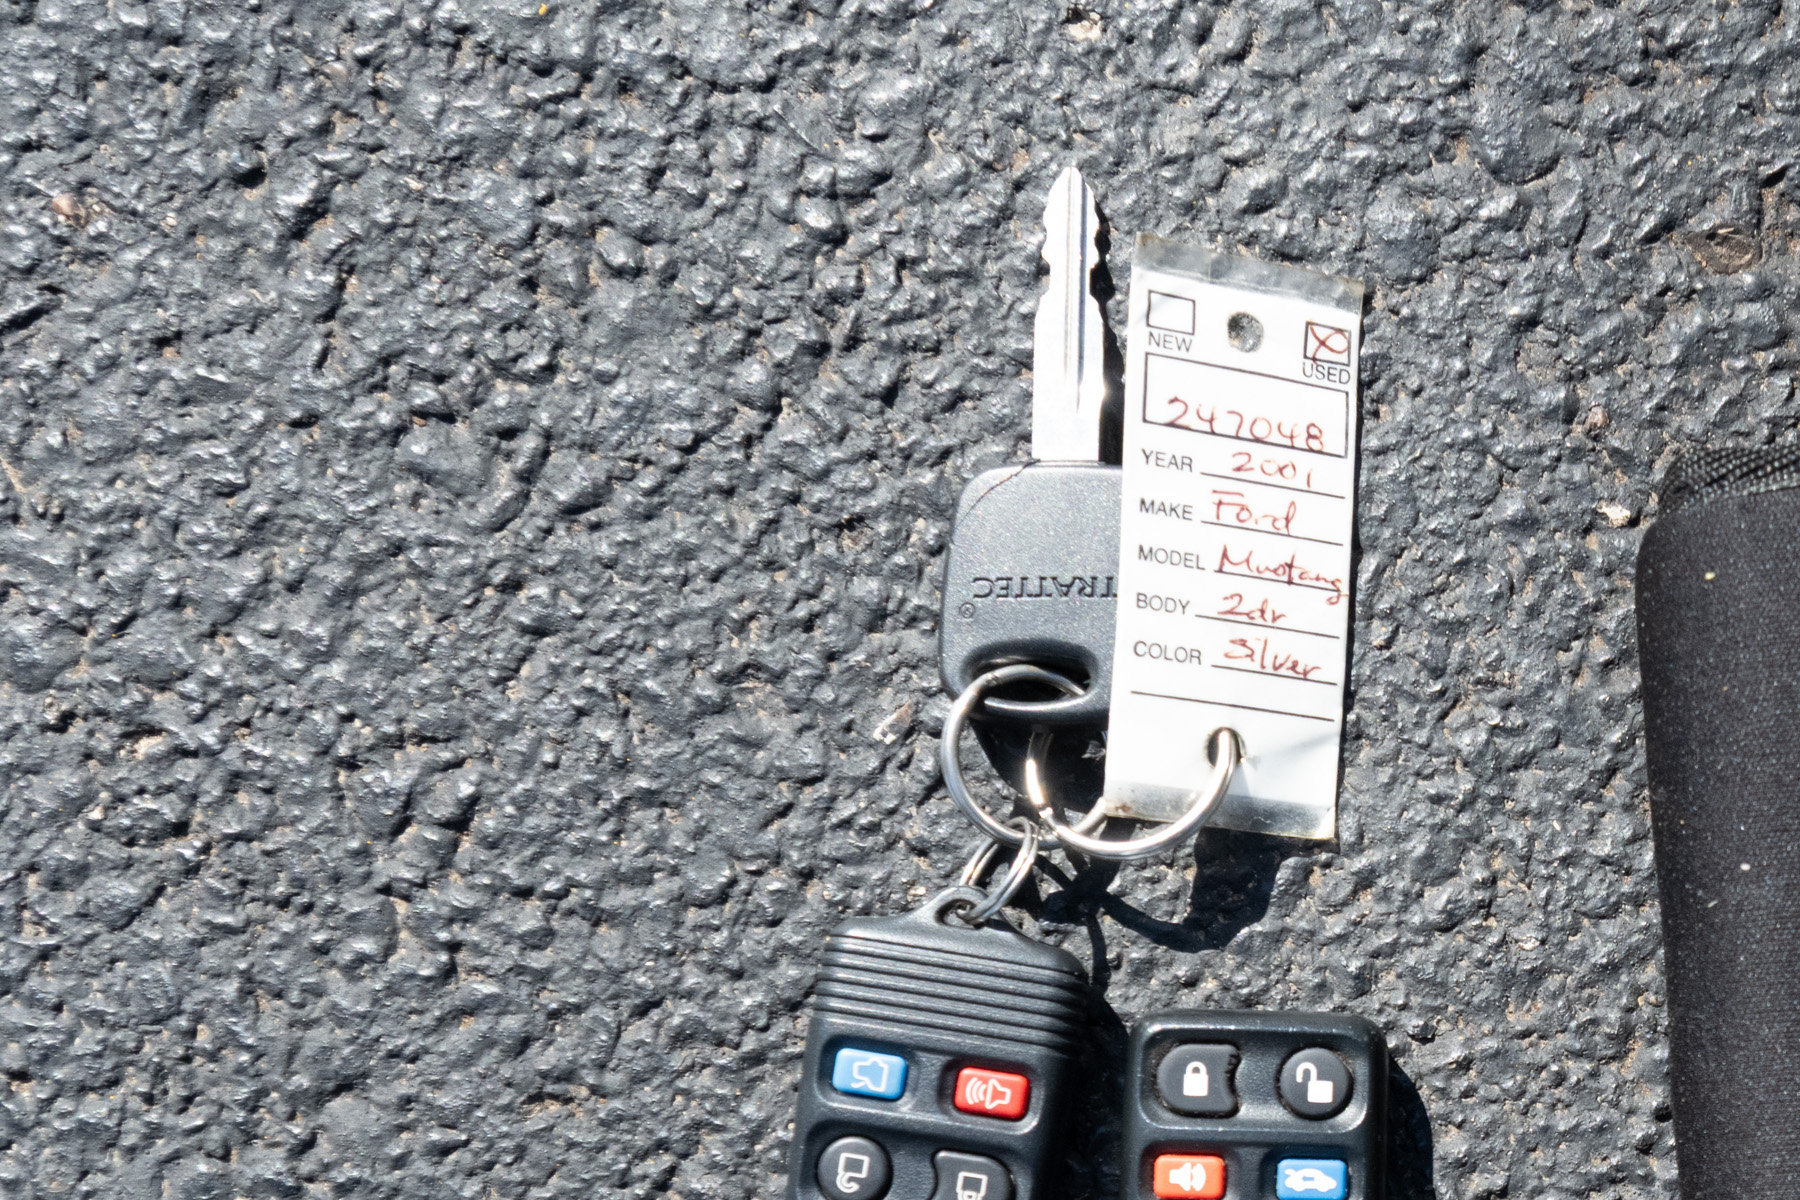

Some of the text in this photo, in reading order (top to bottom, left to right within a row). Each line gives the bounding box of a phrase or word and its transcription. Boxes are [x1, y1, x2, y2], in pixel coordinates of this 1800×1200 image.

[1148, 331, 1193, 352] NEW
[1302, 362, 1351, 385] USED
[1165, 396, 1324, 452] 247048
[1141, 449, 1312, 488] YEAR 2001
[1139, 490, 1296, 534] MAKE Ford
[972, 576, 1118, 599] TRATTEC
[1138, 545, 1350, 605] MODEL Mustang
[1136, 593, 1286, 623] BODY 2dr
[1133, 638, 1321, 680] COLOR Silver
